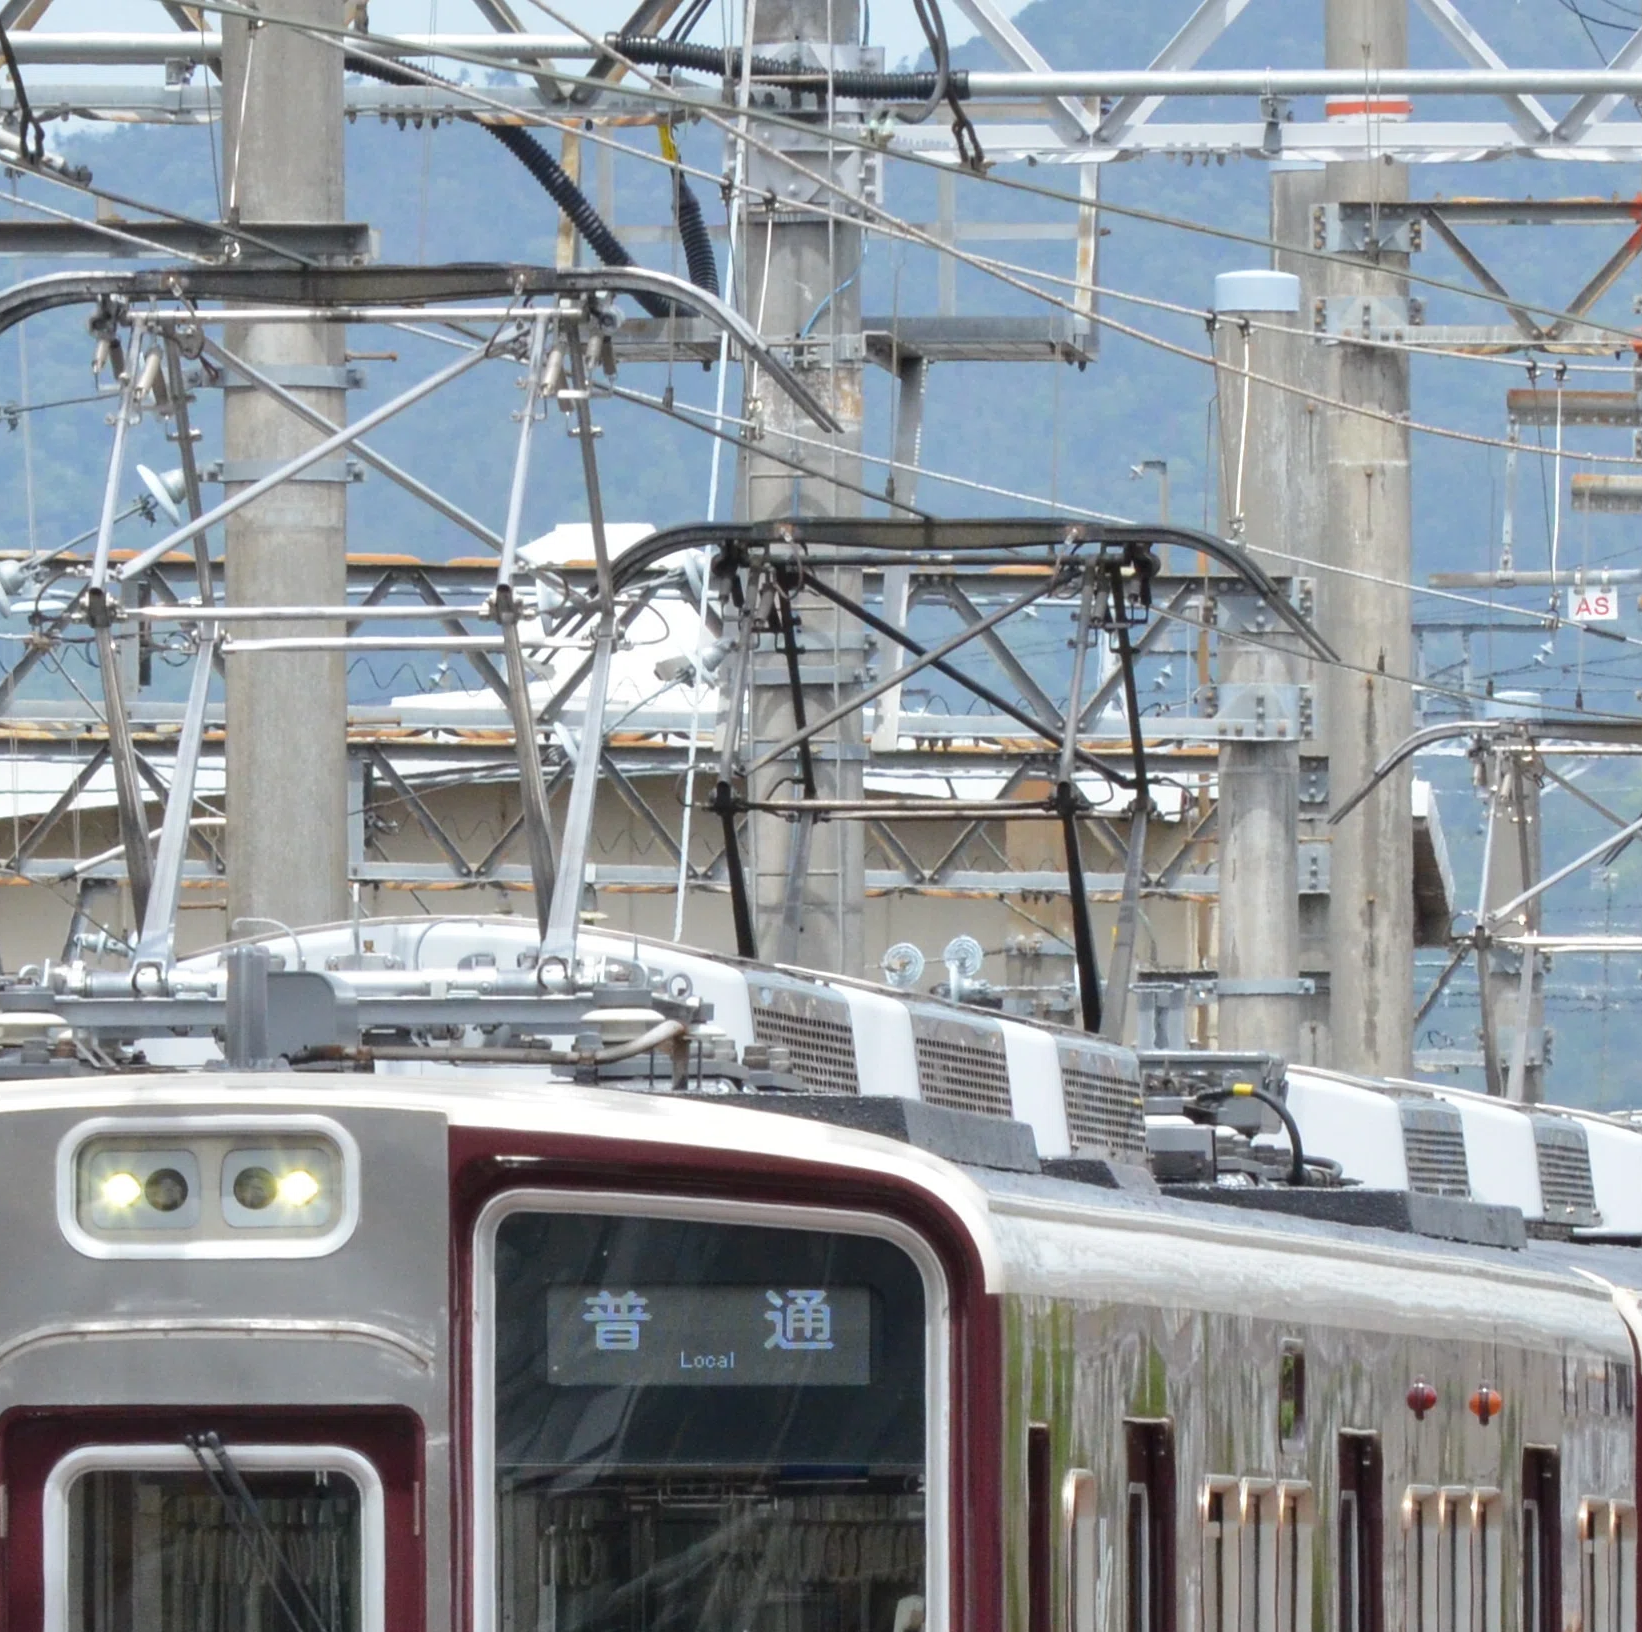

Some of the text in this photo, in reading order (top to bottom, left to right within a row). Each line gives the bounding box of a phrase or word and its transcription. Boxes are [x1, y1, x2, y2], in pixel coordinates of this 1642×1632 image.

[1575, 596, 1610, 616] AS
[582, 1289, 835, 1351] 普通
[679, 1351, 735, 1369] Local
